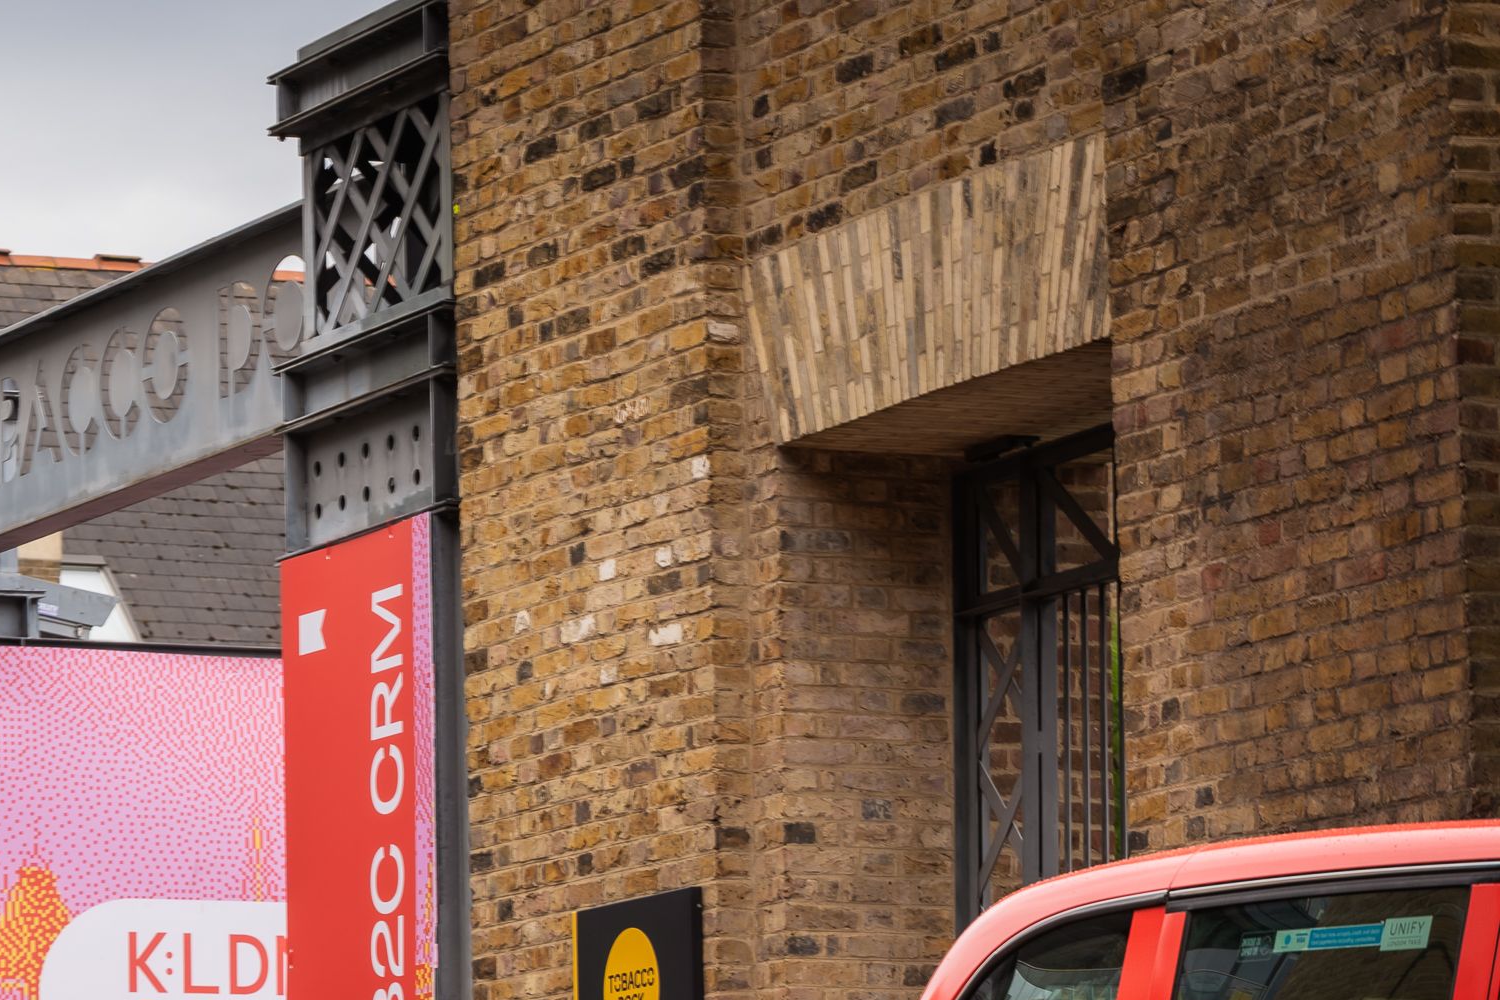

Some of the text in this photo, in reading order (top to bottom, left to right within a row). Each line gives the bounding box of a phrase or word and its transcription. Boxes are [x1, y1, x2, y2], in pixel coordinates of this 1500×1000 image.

[369, 582, 405, 816] CRM
[1388, 920, 1426, 937] UNIFY
[608, 967, 656, 994] TOBACCO
